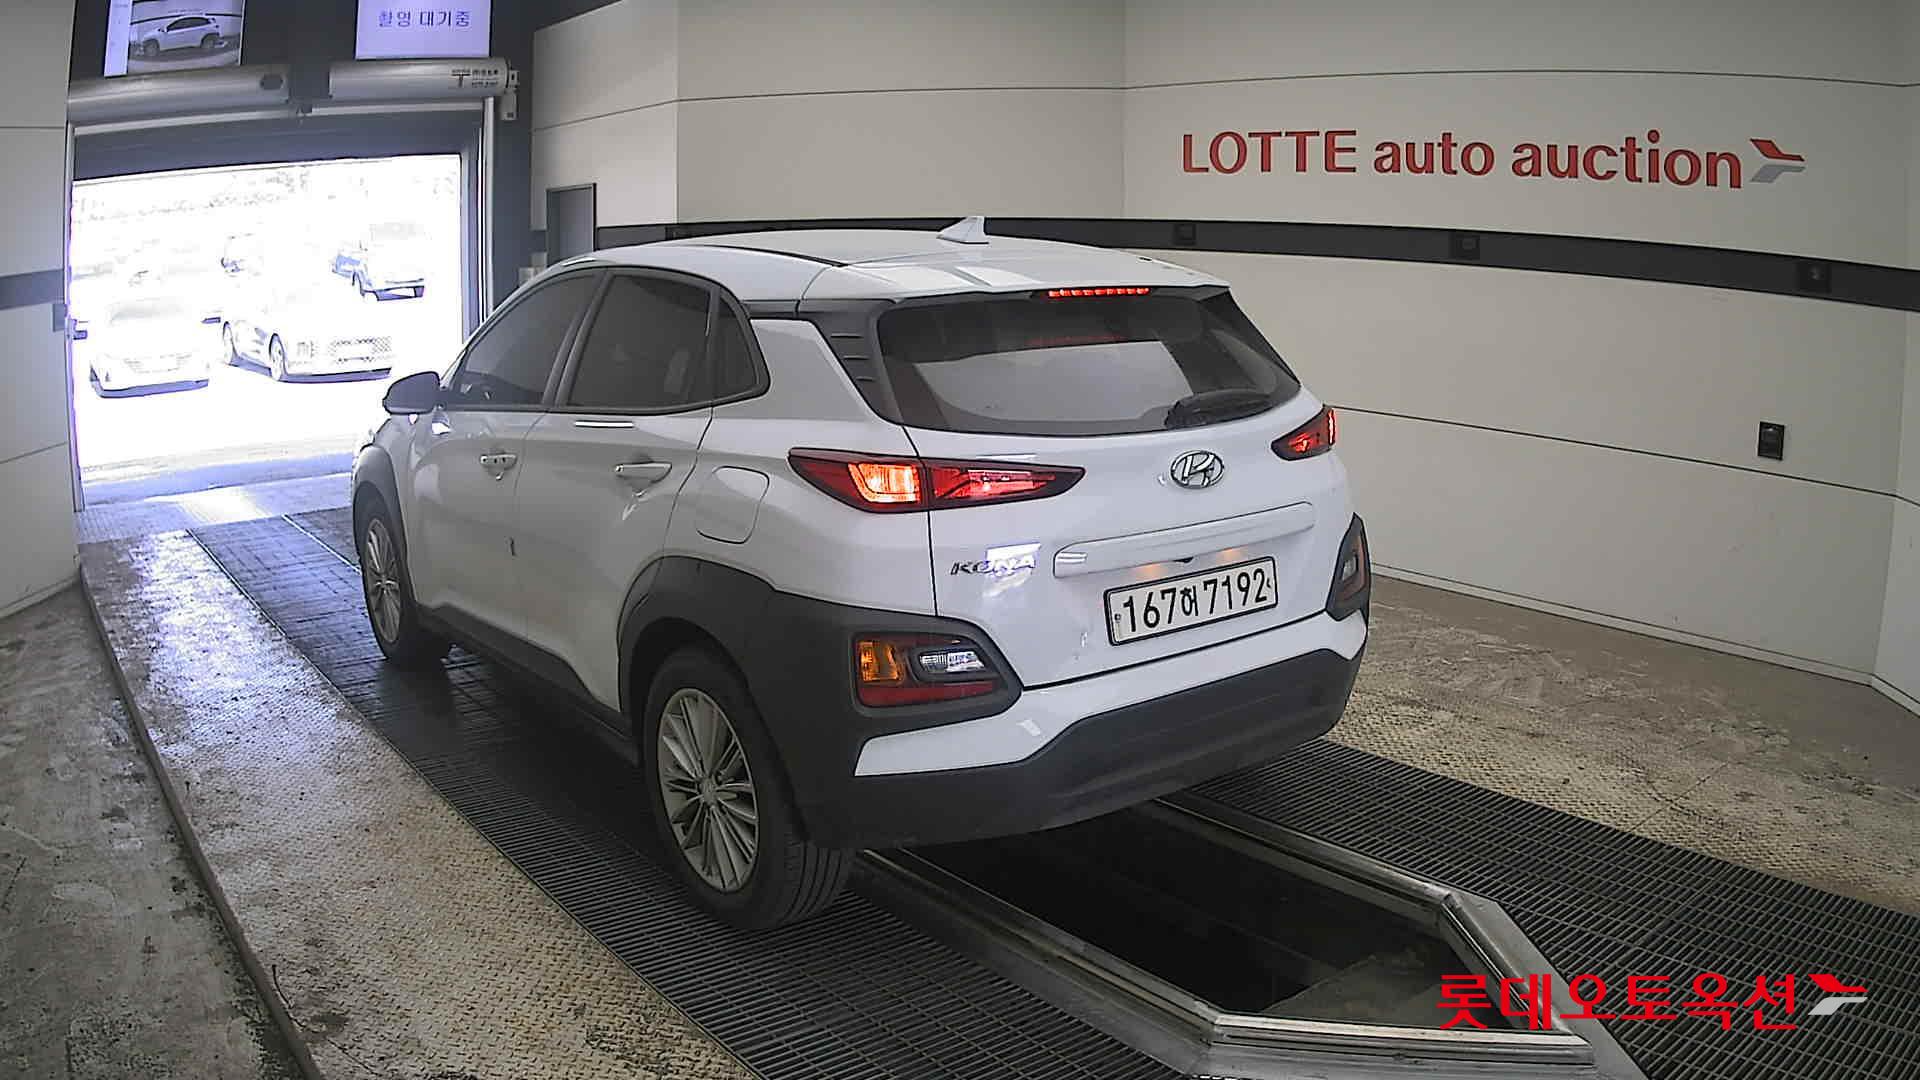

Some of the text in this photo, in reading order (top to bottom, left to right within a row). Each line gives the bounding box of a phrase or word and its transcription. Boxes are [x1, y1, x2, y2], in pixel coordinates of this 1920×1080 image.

[419, 11, 470, 27] 대기중
[1183, 129, 1742, 189] LOTTE auto auction
